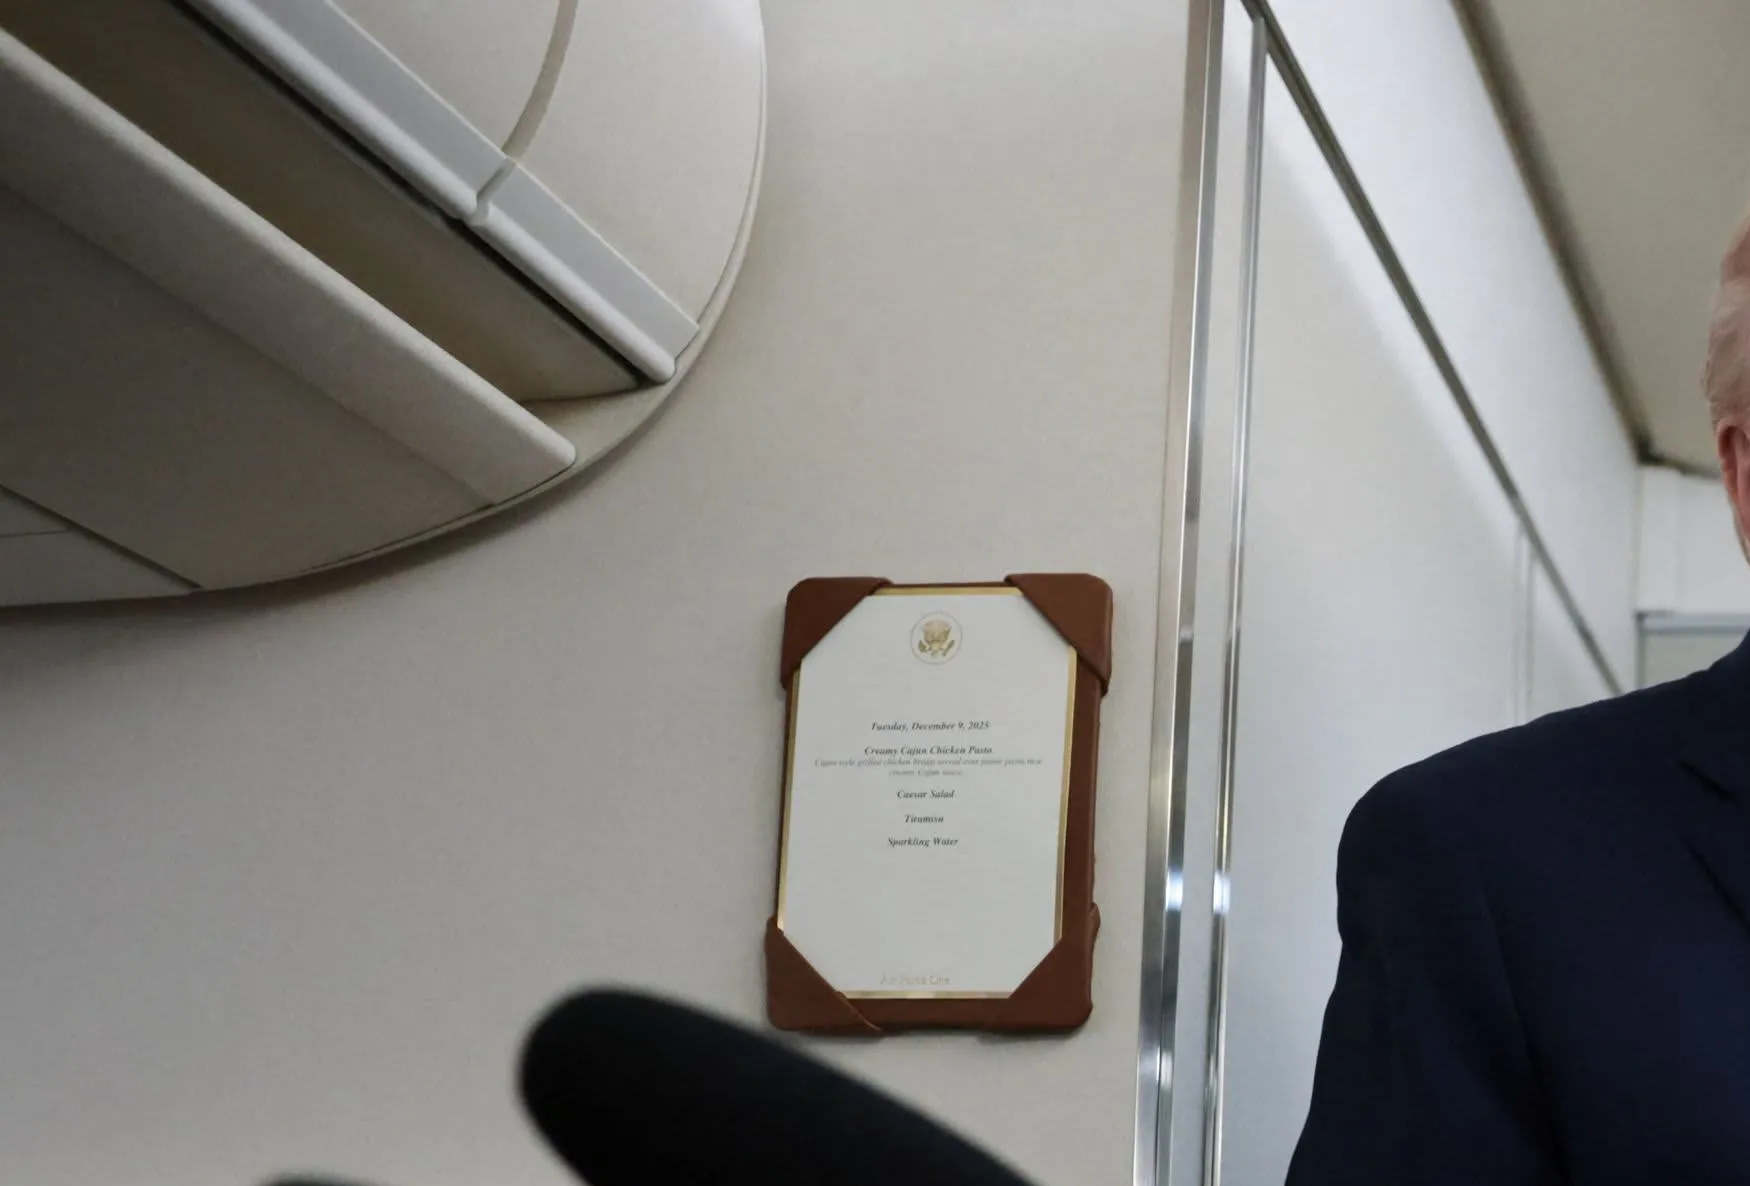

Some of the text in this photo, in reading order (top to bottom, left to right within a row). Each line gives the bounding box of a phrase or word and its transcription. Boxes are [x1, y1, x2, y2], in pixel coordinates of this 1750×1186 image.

[871, 721, 908, 731] Tuesday,
[911, 721, 955, 730] December
[968, 720, 990, 730] 2025
[864, 745, 993, 757] Creamy Cajun Chicken Pasta
[897, 789, 955, 799] Caesar Salad
[905, 814, 944, 823] Tiramisu
[887, 836, 959, 848] Sparkling Water
